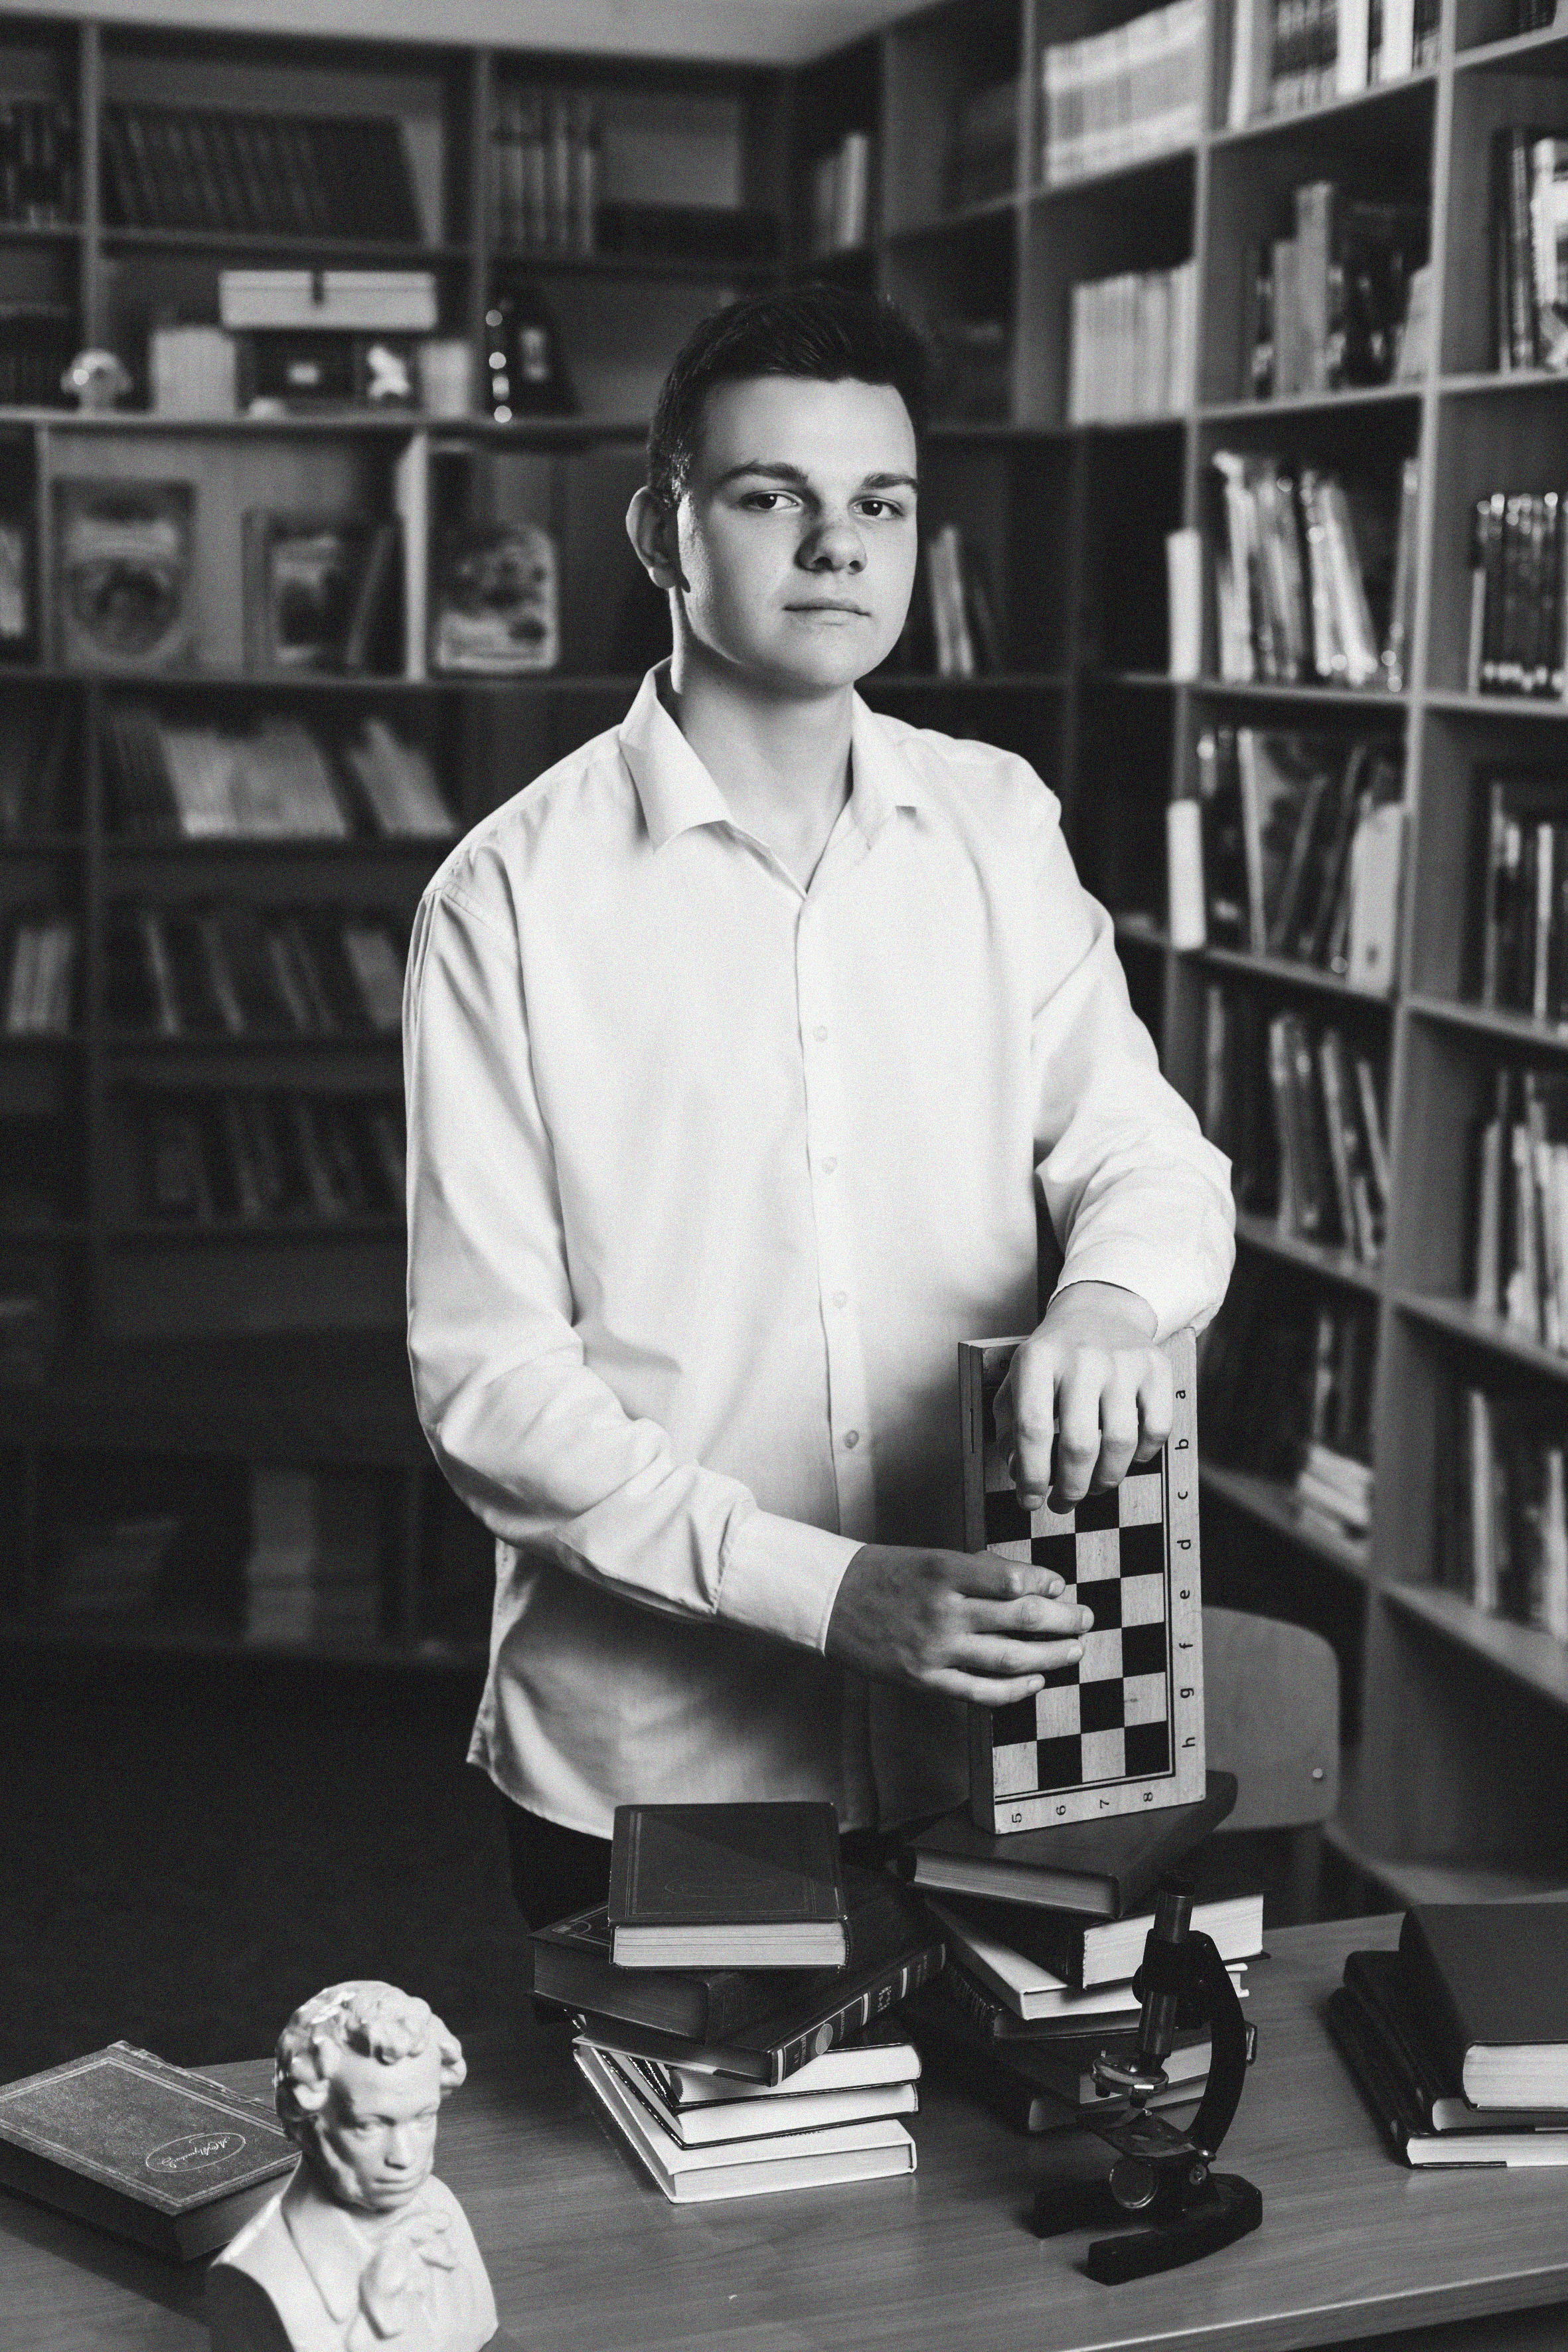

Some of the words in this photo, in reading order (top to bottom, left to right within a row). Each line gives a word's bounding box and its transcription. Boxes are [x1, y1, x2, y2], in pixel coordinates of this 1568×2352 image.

[1175, 1389, 1186, 1399] a
[1174, 1439, 1189, 1450] b
[1177, 1490, 1188, 1500] c
[1176, 1539, 1192, 1550] d
[1180, 1589, 1190, 1600] e
[1180, 1687, 1195, 1699] g
[1182, 1737, 1196, 1749] h
[1011, 1812, 1022, 1824] 5
[1056, 1805, 1066, 1816] 6
[1099, 1799, 1110, 1809] 7
[1143, 1792, 1153, 1802] 8
